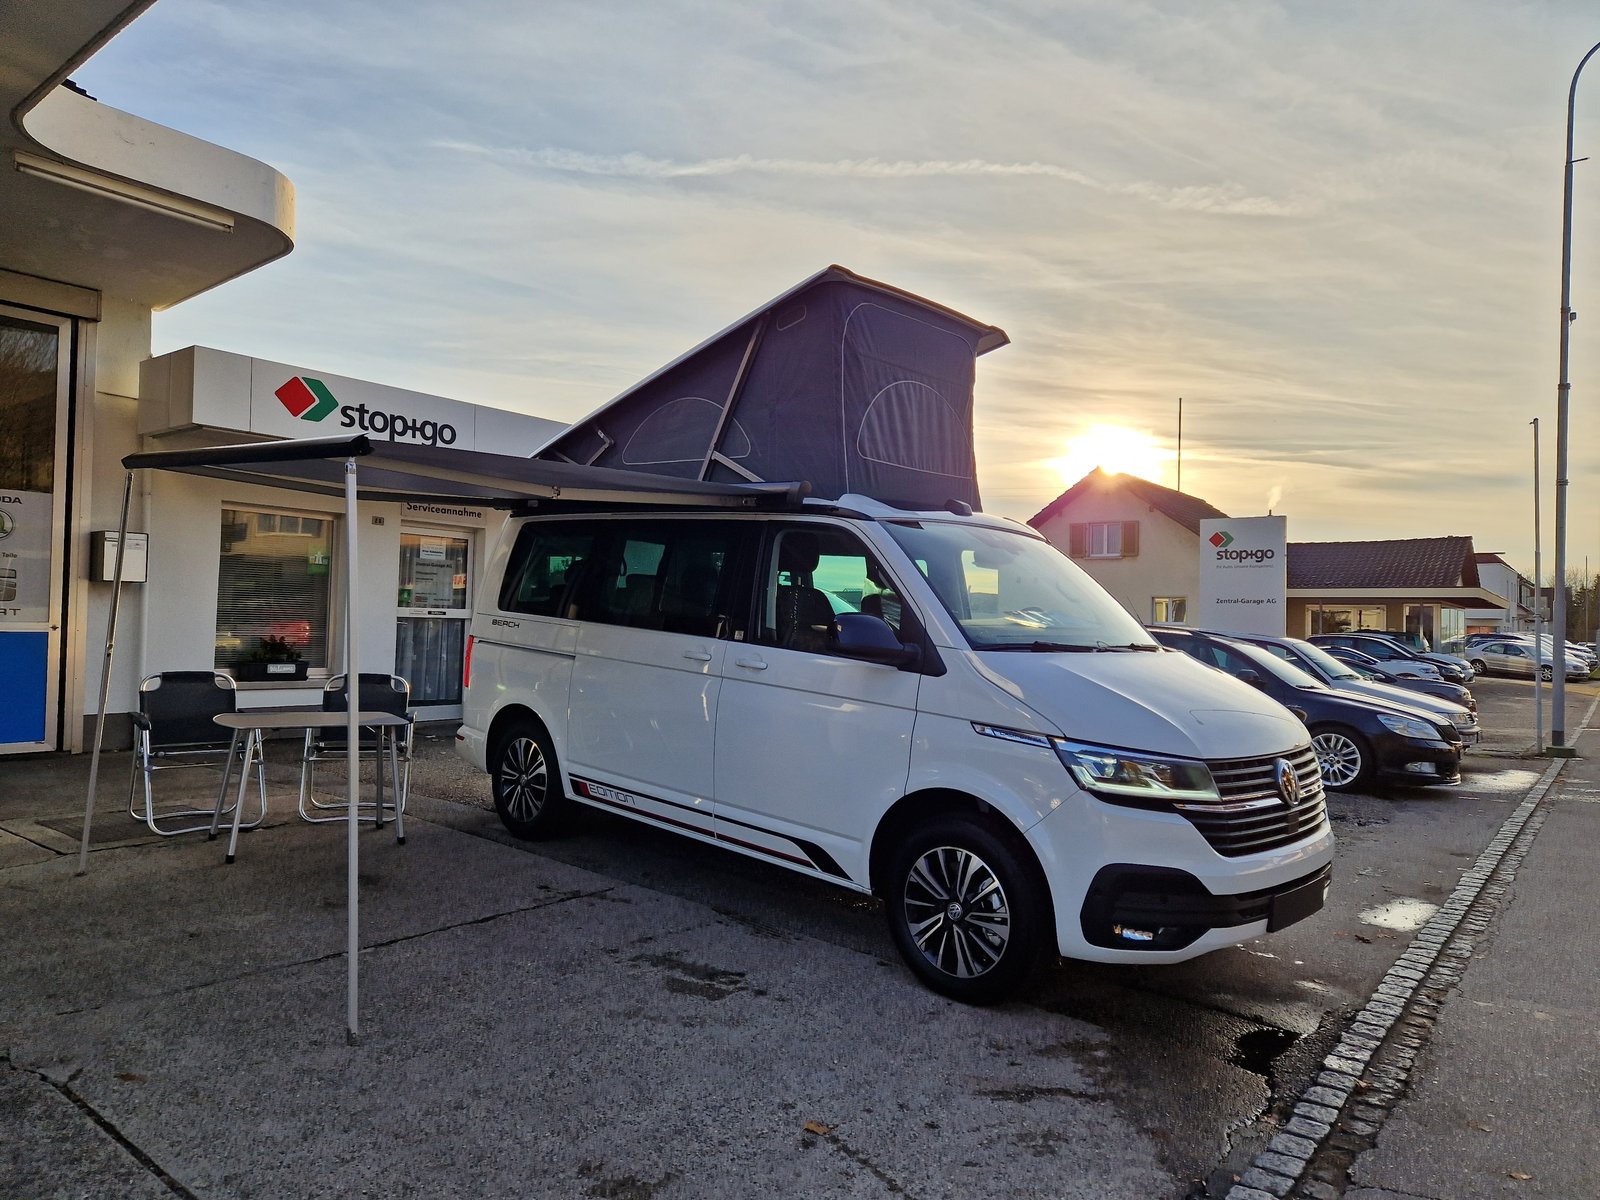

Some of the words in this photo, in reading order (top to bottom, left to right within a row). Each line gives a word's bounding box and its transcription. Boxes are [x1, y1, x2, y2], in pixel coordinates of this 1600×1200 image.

[340, 403, 457, 446] stop+go
[0, 495, 23, 504] DA
[406, 502, 482, 518] Serviceannahme
[1216, 548, 1275, 563] stop+go
[491, 619, 520, 629] BEACH
[589, 784, 636, 805] EDITION
